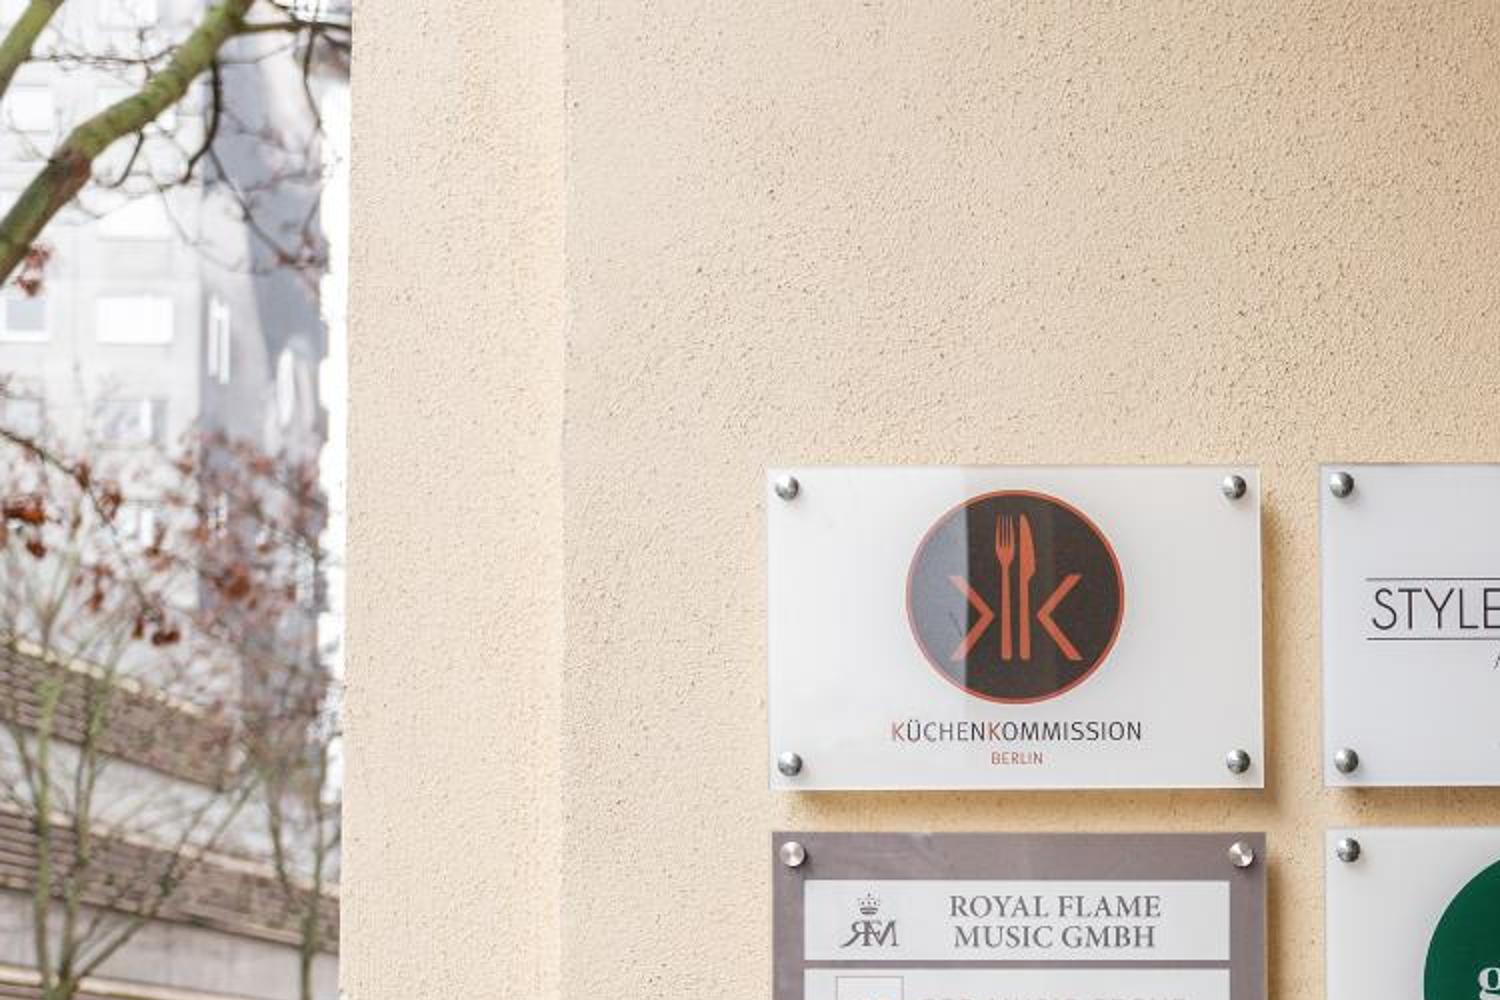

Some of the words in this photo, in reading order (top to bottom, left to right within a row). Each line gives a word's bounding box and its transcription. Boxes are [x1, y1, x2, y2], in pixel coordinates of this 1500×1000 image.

[891, 717, 1142, 743] KÜCHENKOMMISSION
[990, 751, 1044, 766] BERLIN
[949, 895, 1050, 919] ROYAL
[1058, 895, 1162, 919] FLAME
[953, 925, 1054, 949] MUSIC
[1061, 925, 1156, 949] GMBH
